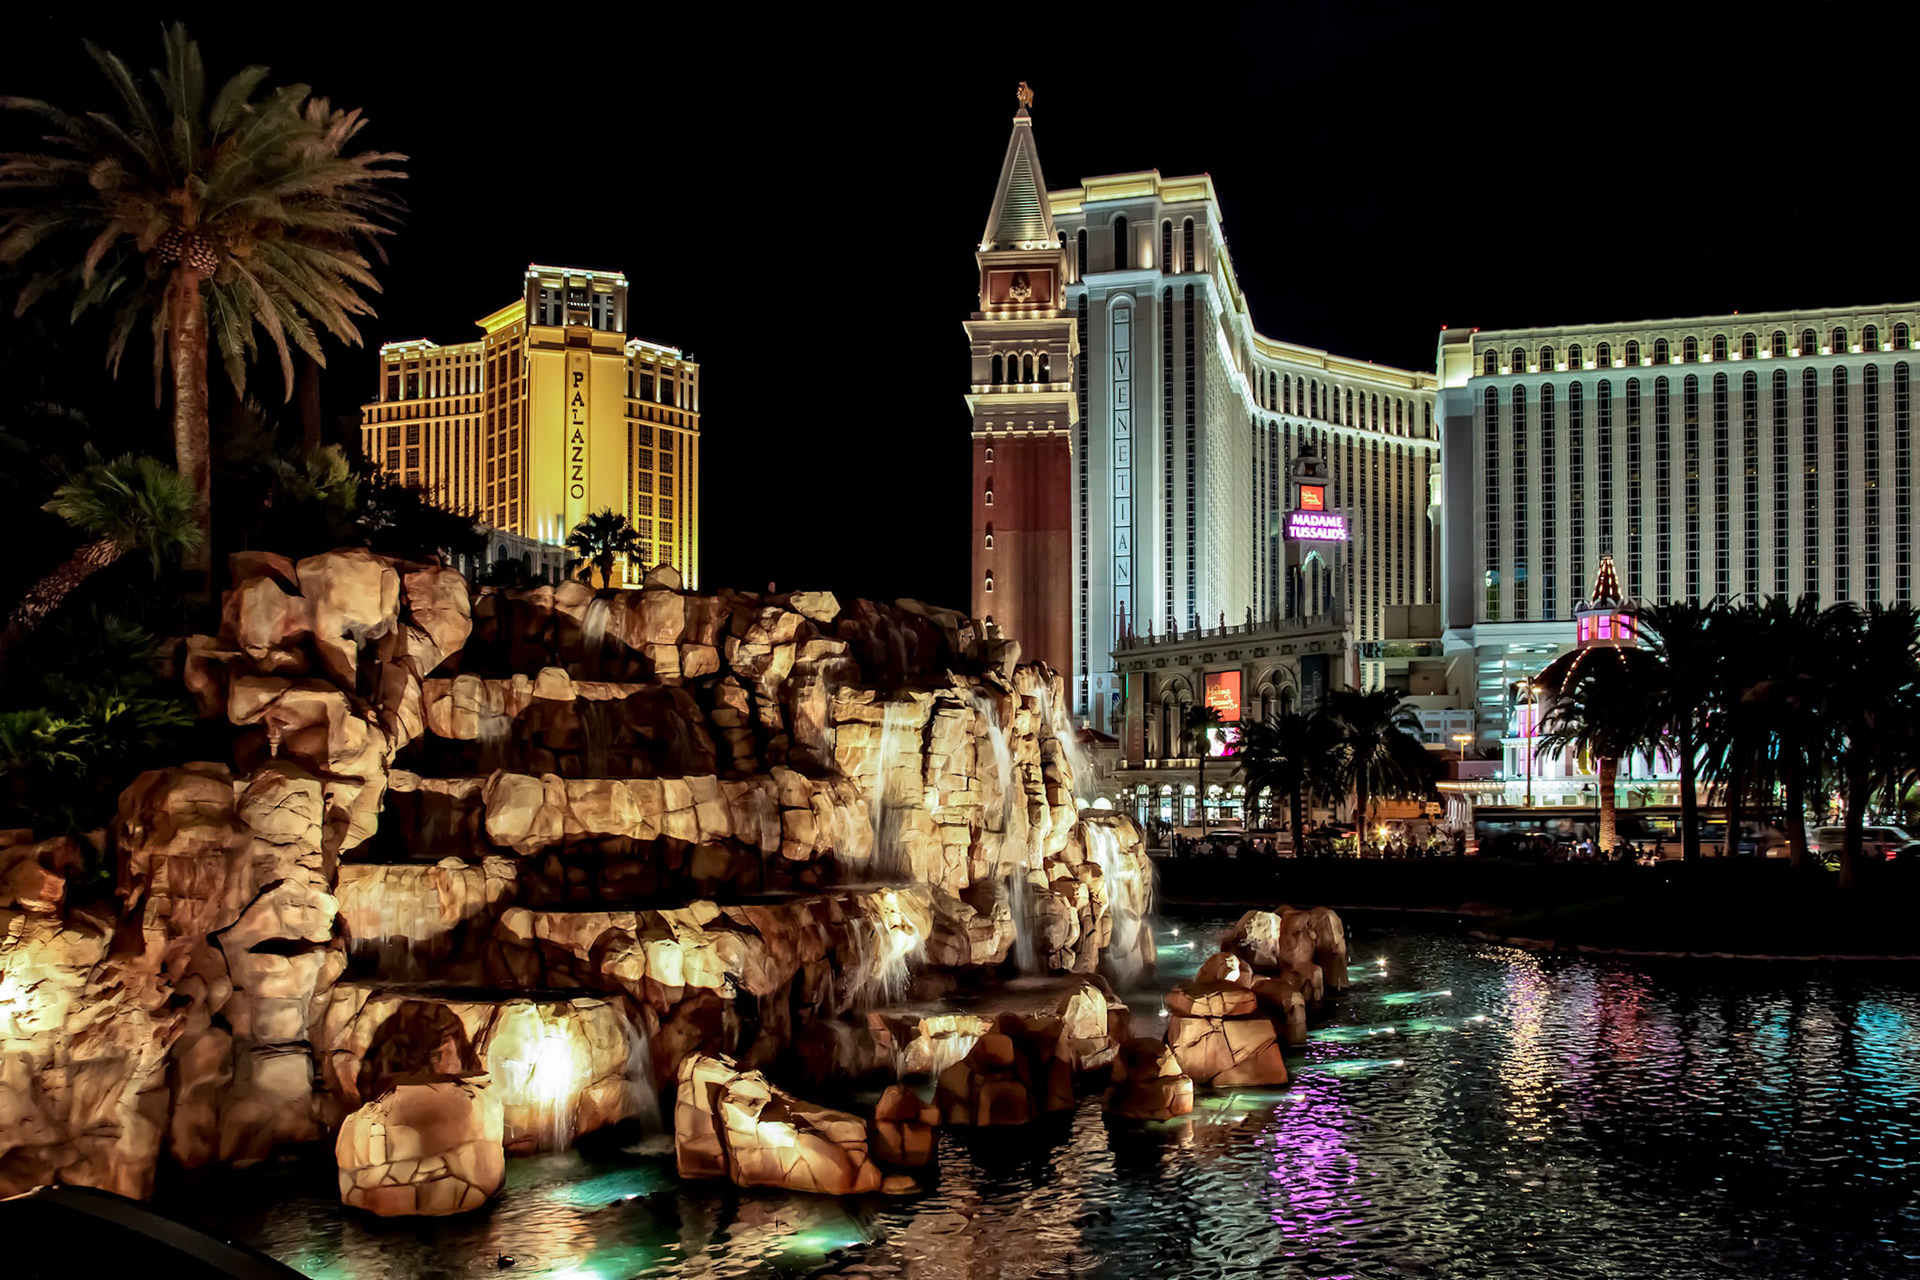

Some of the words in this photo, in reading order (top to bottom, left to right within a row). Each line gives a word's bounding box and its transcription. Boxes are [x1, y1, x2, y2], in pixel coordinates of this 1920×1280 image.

[571, 372, 585, 500] PALAZZO
[1116, 356, 1128, 579] VENETIAN
[1292, 514, 1343, 527] MADAME
